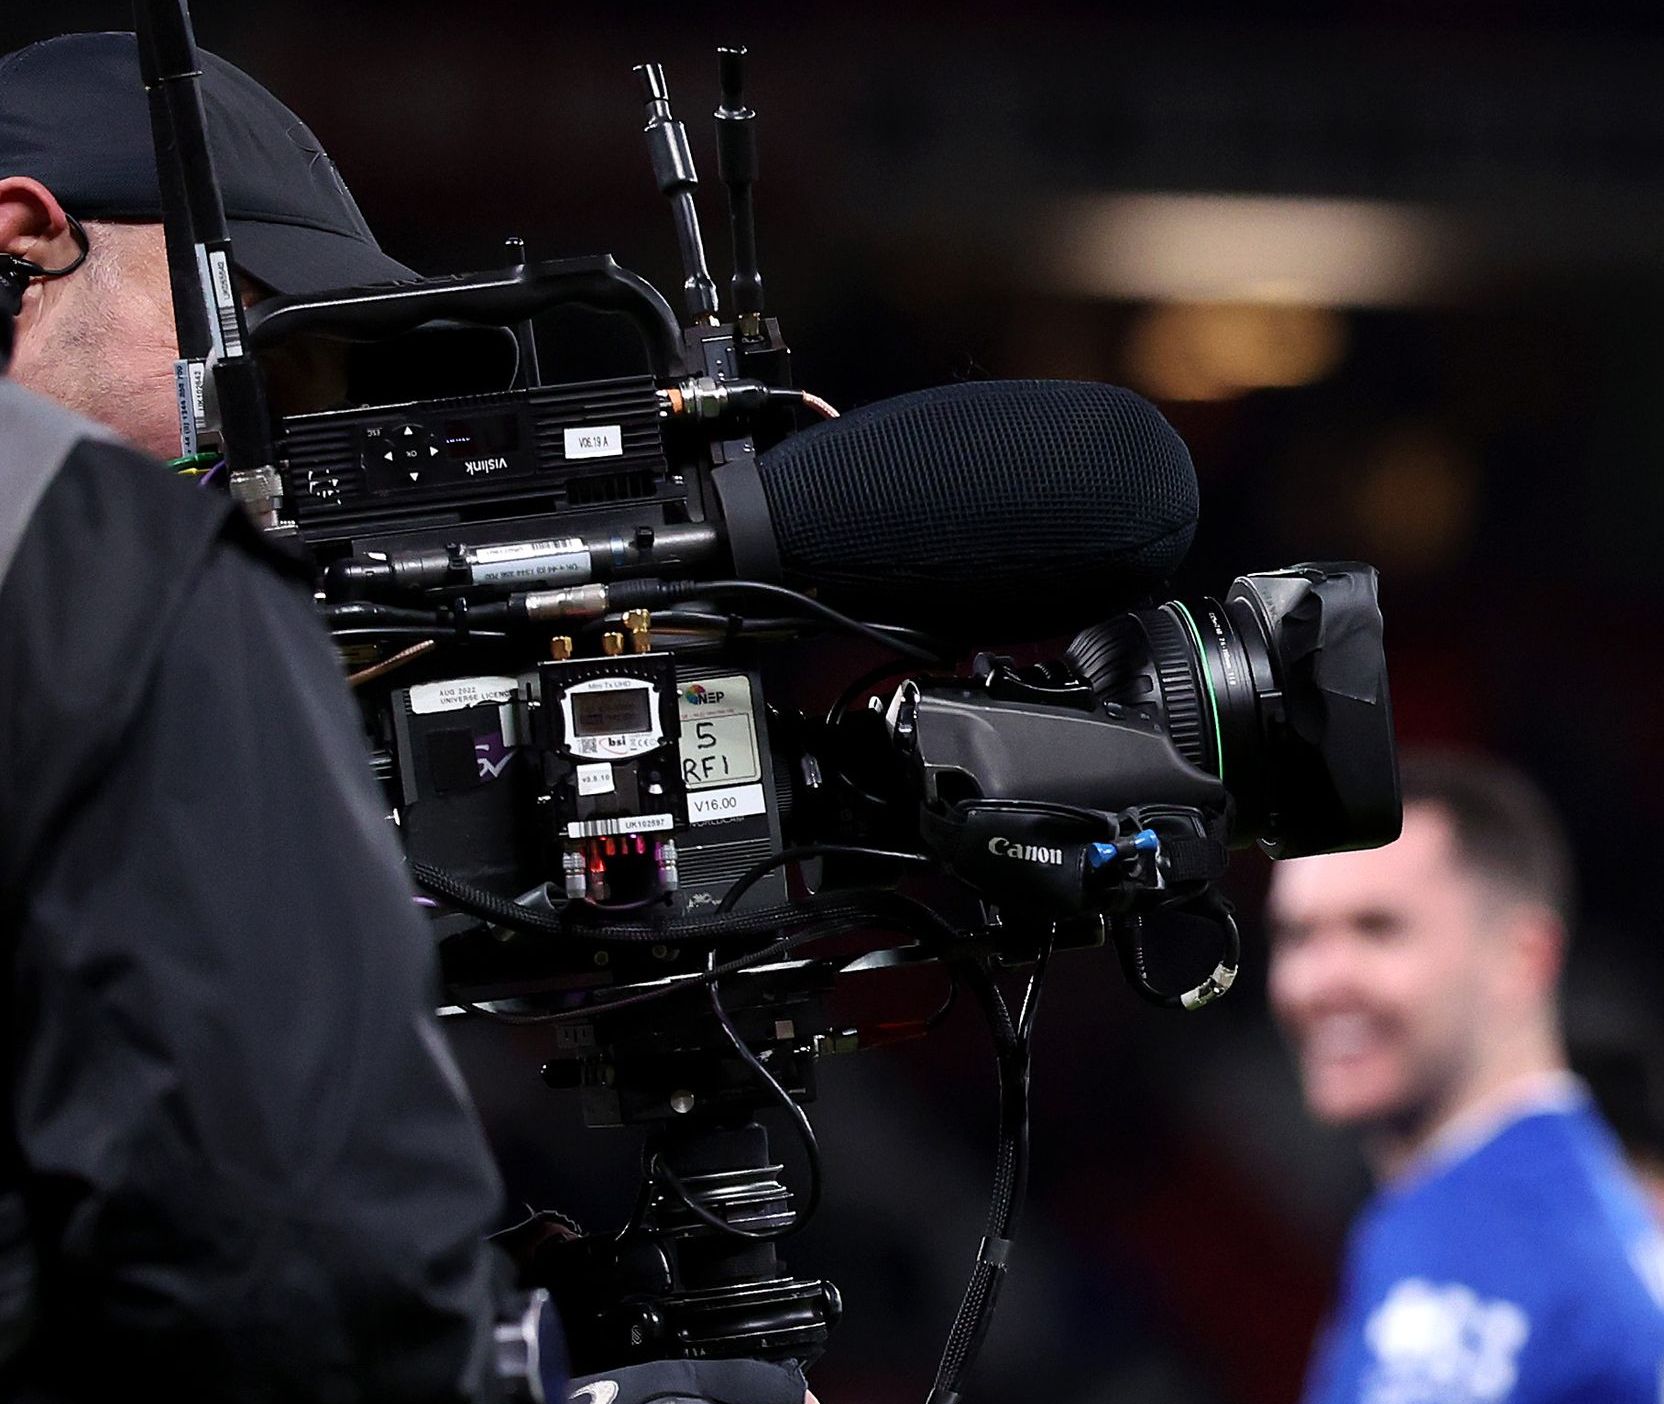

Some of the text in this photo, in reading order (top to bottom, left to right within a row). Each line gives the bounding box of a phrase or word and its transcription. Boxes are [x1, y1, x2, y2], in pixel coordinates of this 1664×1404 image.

[481, 690, 513, 700] LICENC
[698, 691, 725, 705] NEP
[608, 736, 626, 747] bsi
[696, 722, 717, 749] 5
[694, 797, 737, 812] V16.00
[988, 836, 1063, 865] Canon
